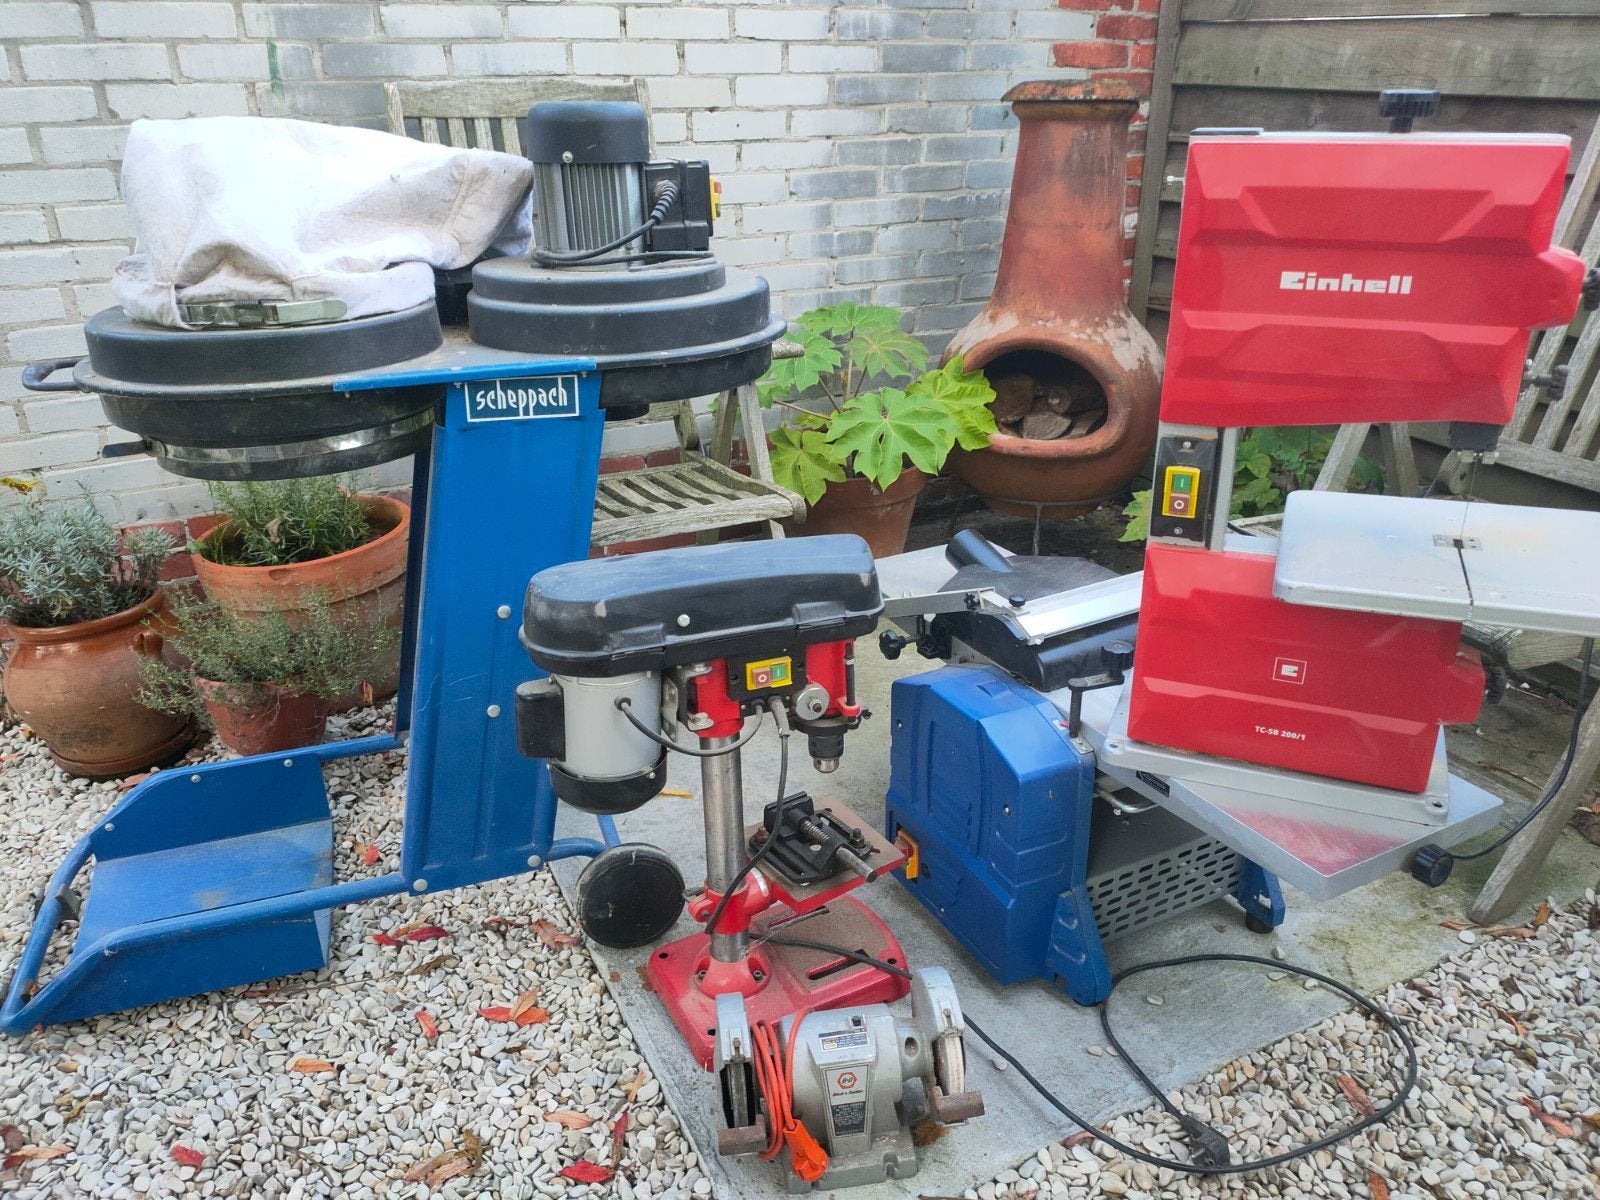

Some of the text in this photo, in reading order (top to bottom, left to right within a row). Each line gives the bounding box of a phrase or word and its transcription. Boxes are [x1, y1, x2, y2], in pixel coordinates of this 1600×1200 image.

[1280, 271, 1413, 294] Einhell
[476, 378, 568, 416] scheppach
[1255, 725, 1306, 741] TC-SB 200/1
